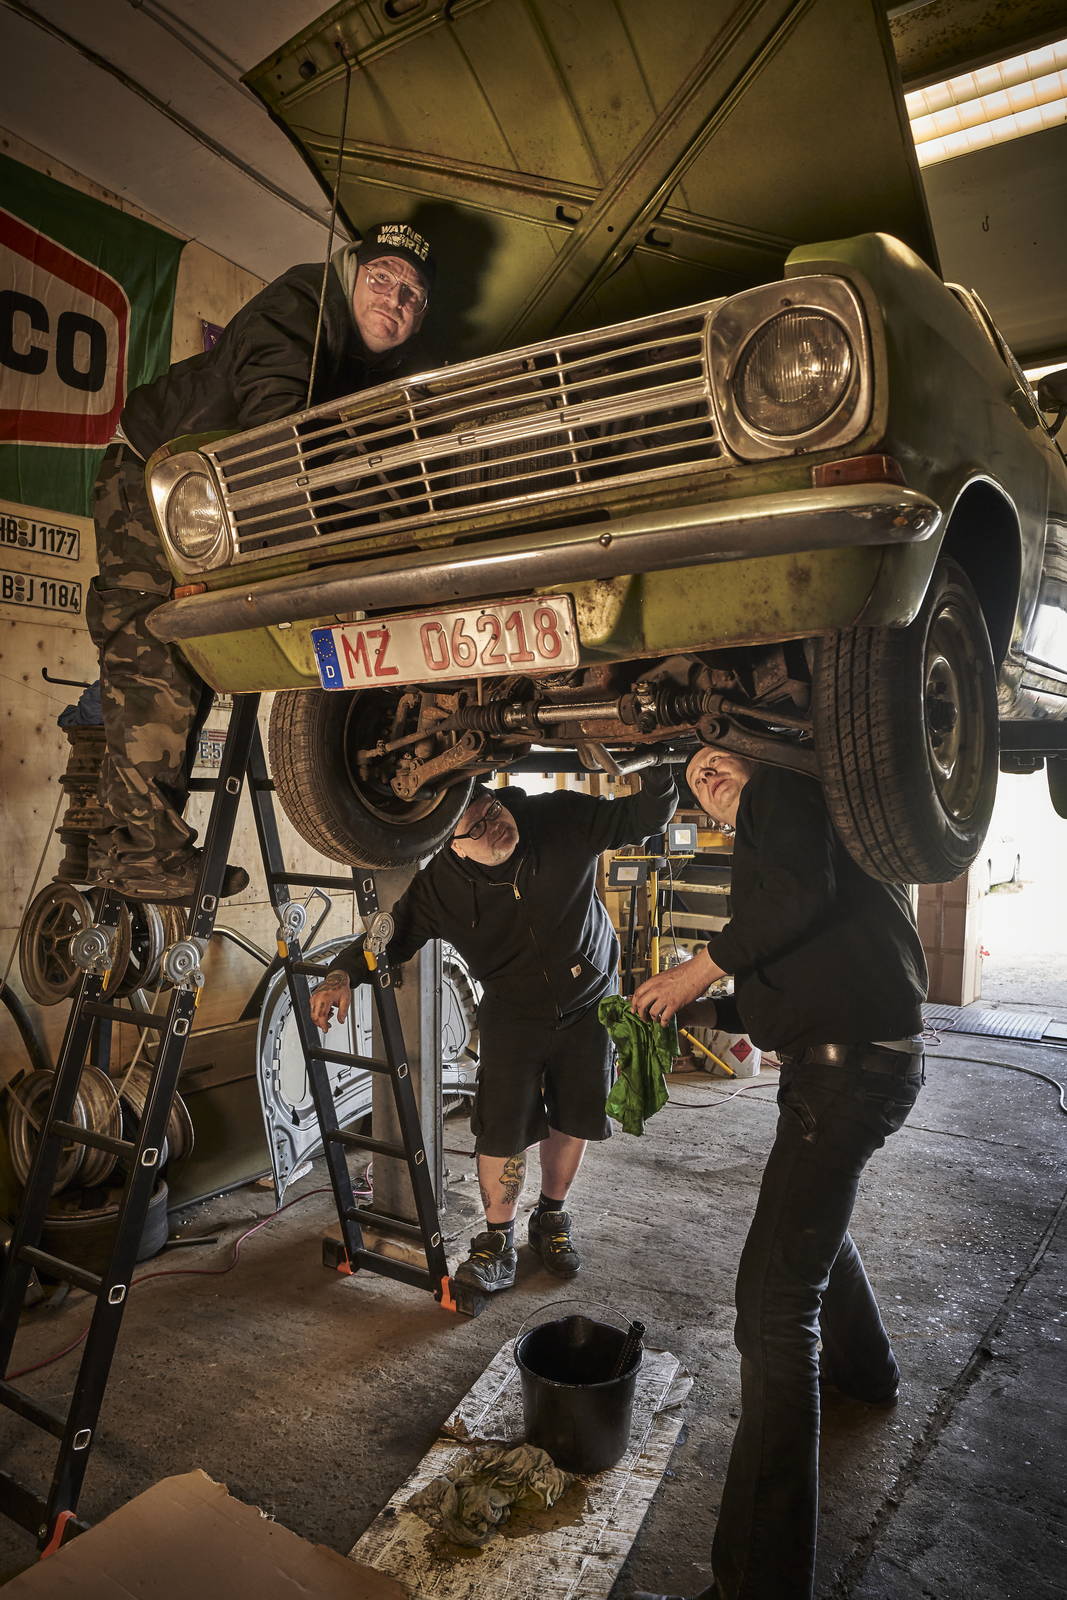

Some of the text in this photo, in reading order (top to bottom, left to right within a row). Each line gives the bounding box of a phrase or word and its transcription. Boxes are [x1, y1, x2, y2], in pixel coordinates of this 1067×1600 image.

[381, 224, 430, 251] WAYNE'S
[0, 290, 107, 392] CO
[40, 581, 79, 609] 1184
[325, 607, 562, 679] D MZ 06218
